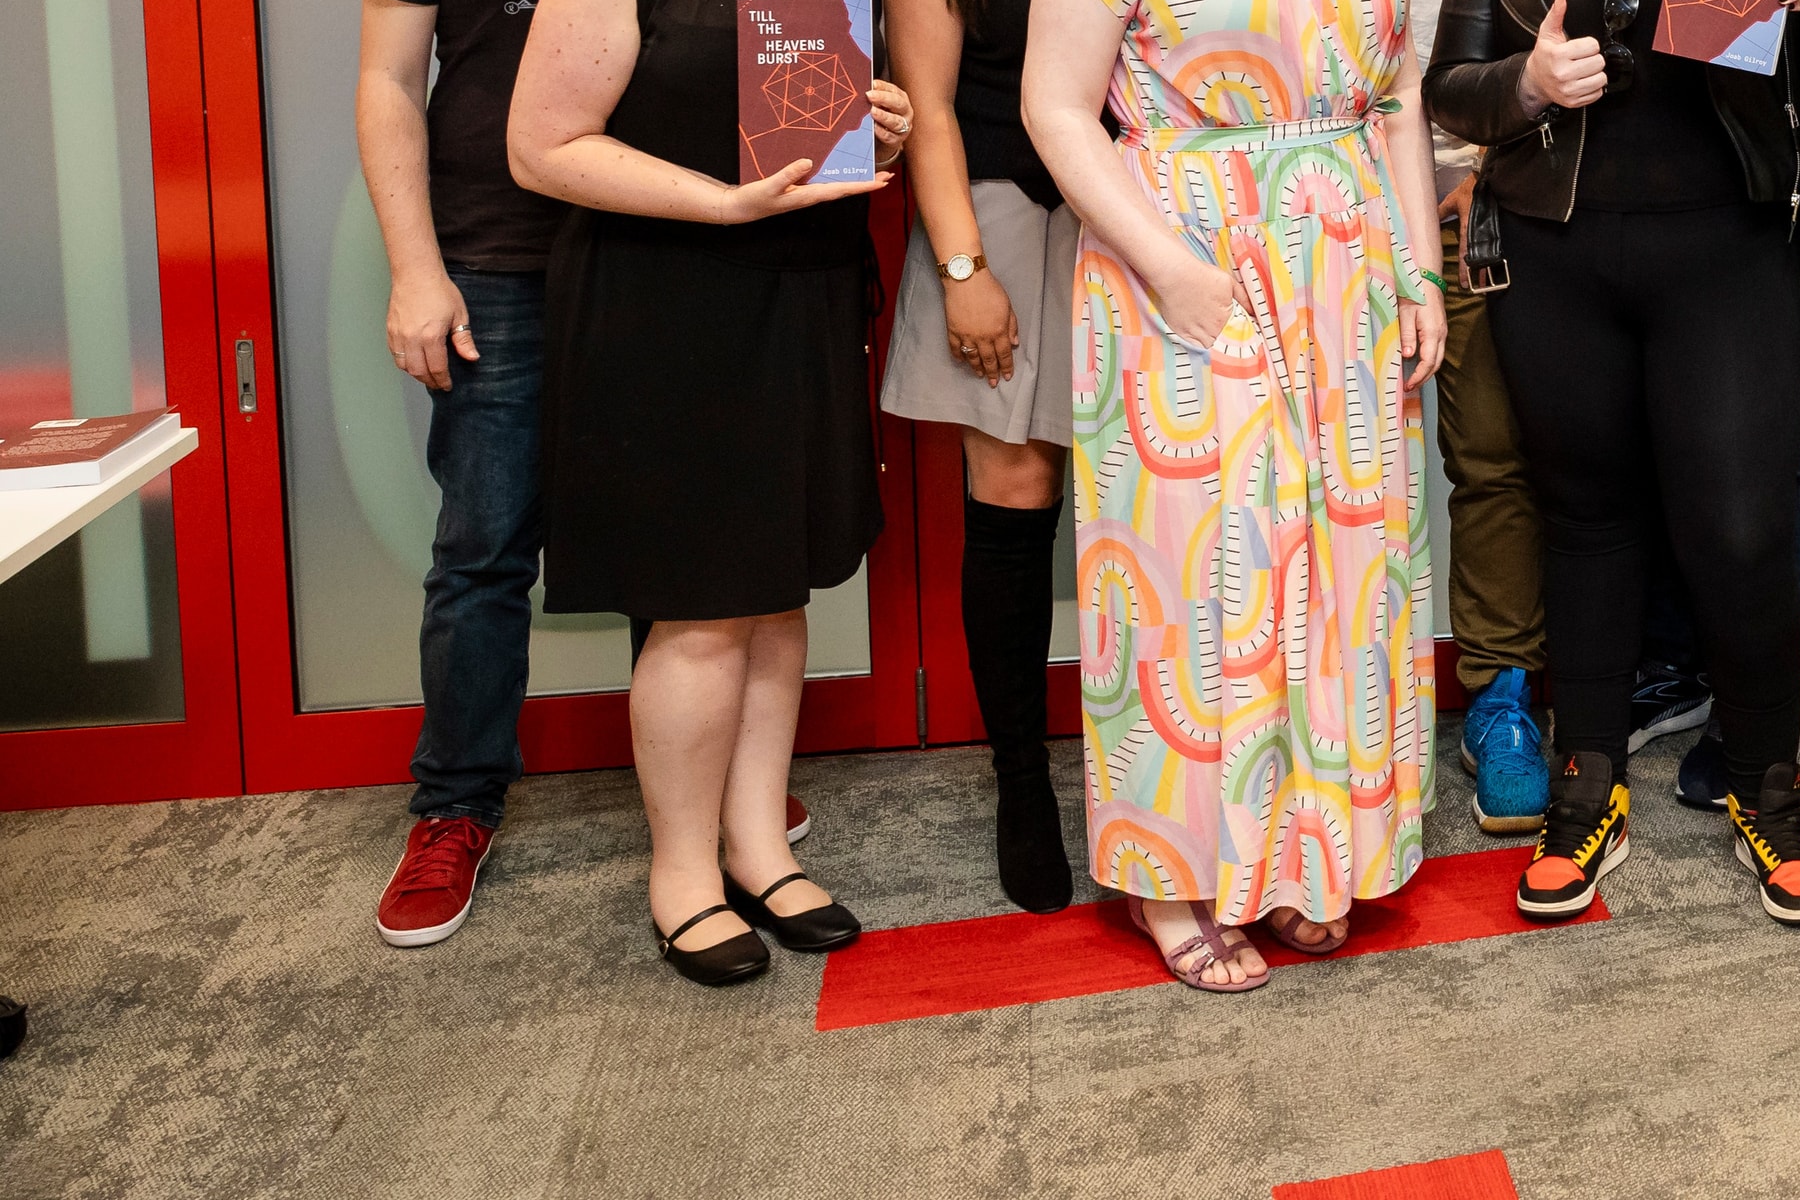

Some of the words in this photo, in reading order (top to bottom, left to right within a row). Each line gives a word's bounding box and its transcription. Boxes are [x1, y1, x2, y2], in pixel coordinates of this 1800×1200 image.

[749, 10, 776, 22] TILL
[757, 23, 782, 35] THE
[766, 39, 825, 52] HEAVENS
[757, 52, 800, 65] BURST
[1744, 55, 1768, 67] Gilroy
[843, 167, 868, 175] Gilroy
